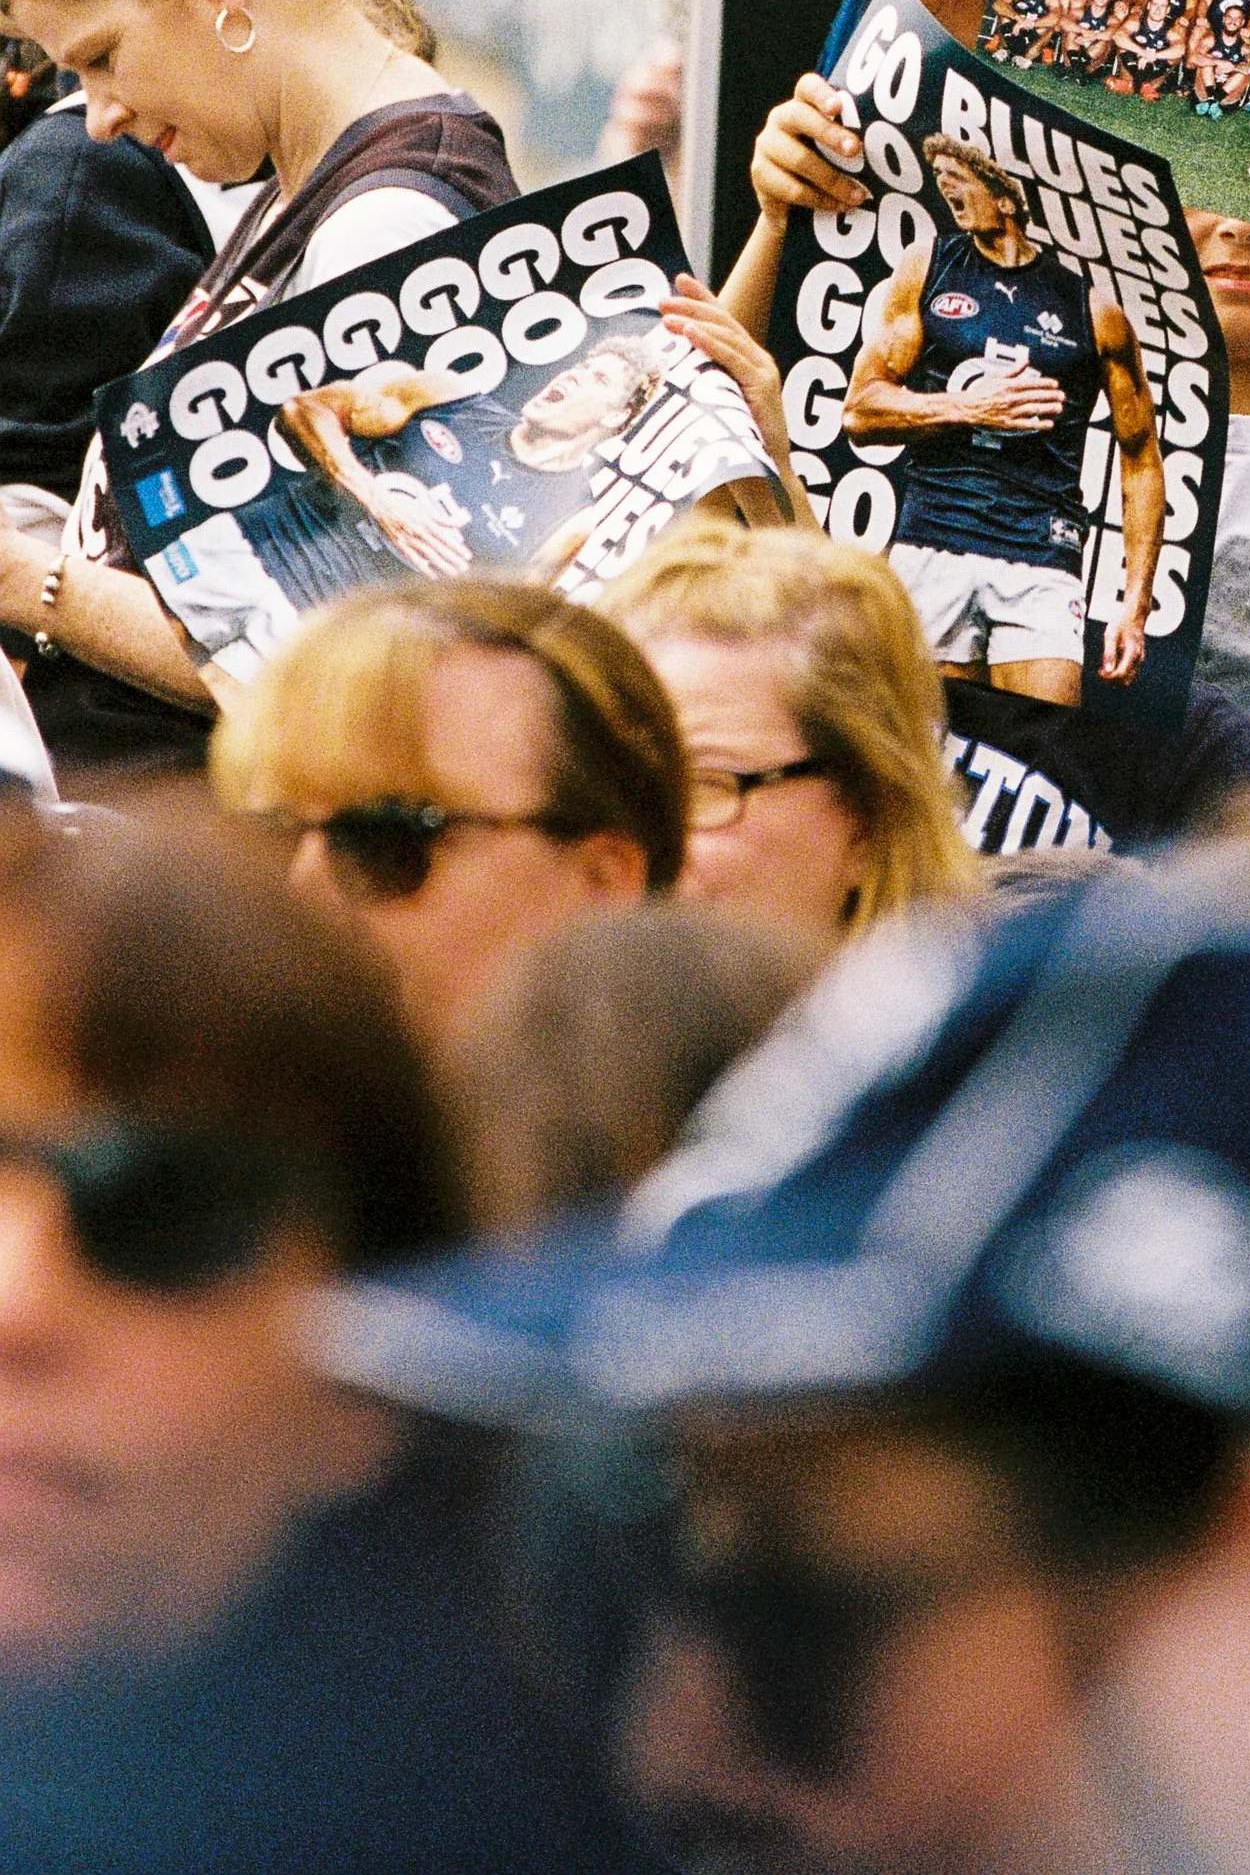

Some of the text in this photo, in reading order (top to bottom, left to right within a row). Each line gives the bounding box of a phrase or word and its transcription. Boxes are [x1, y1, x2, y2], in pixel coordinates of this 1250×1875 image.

[847, 5, 1170, 227] GO BLUES
[478, 223, 588, 365] GO
[561, 191, 671, 317] GO
[1007, 175, 1190, 291] UES
[399, 257, 508, 394] GO
[935, 296, 975, 317] AFL
[169, 361, 272, 509] GO
